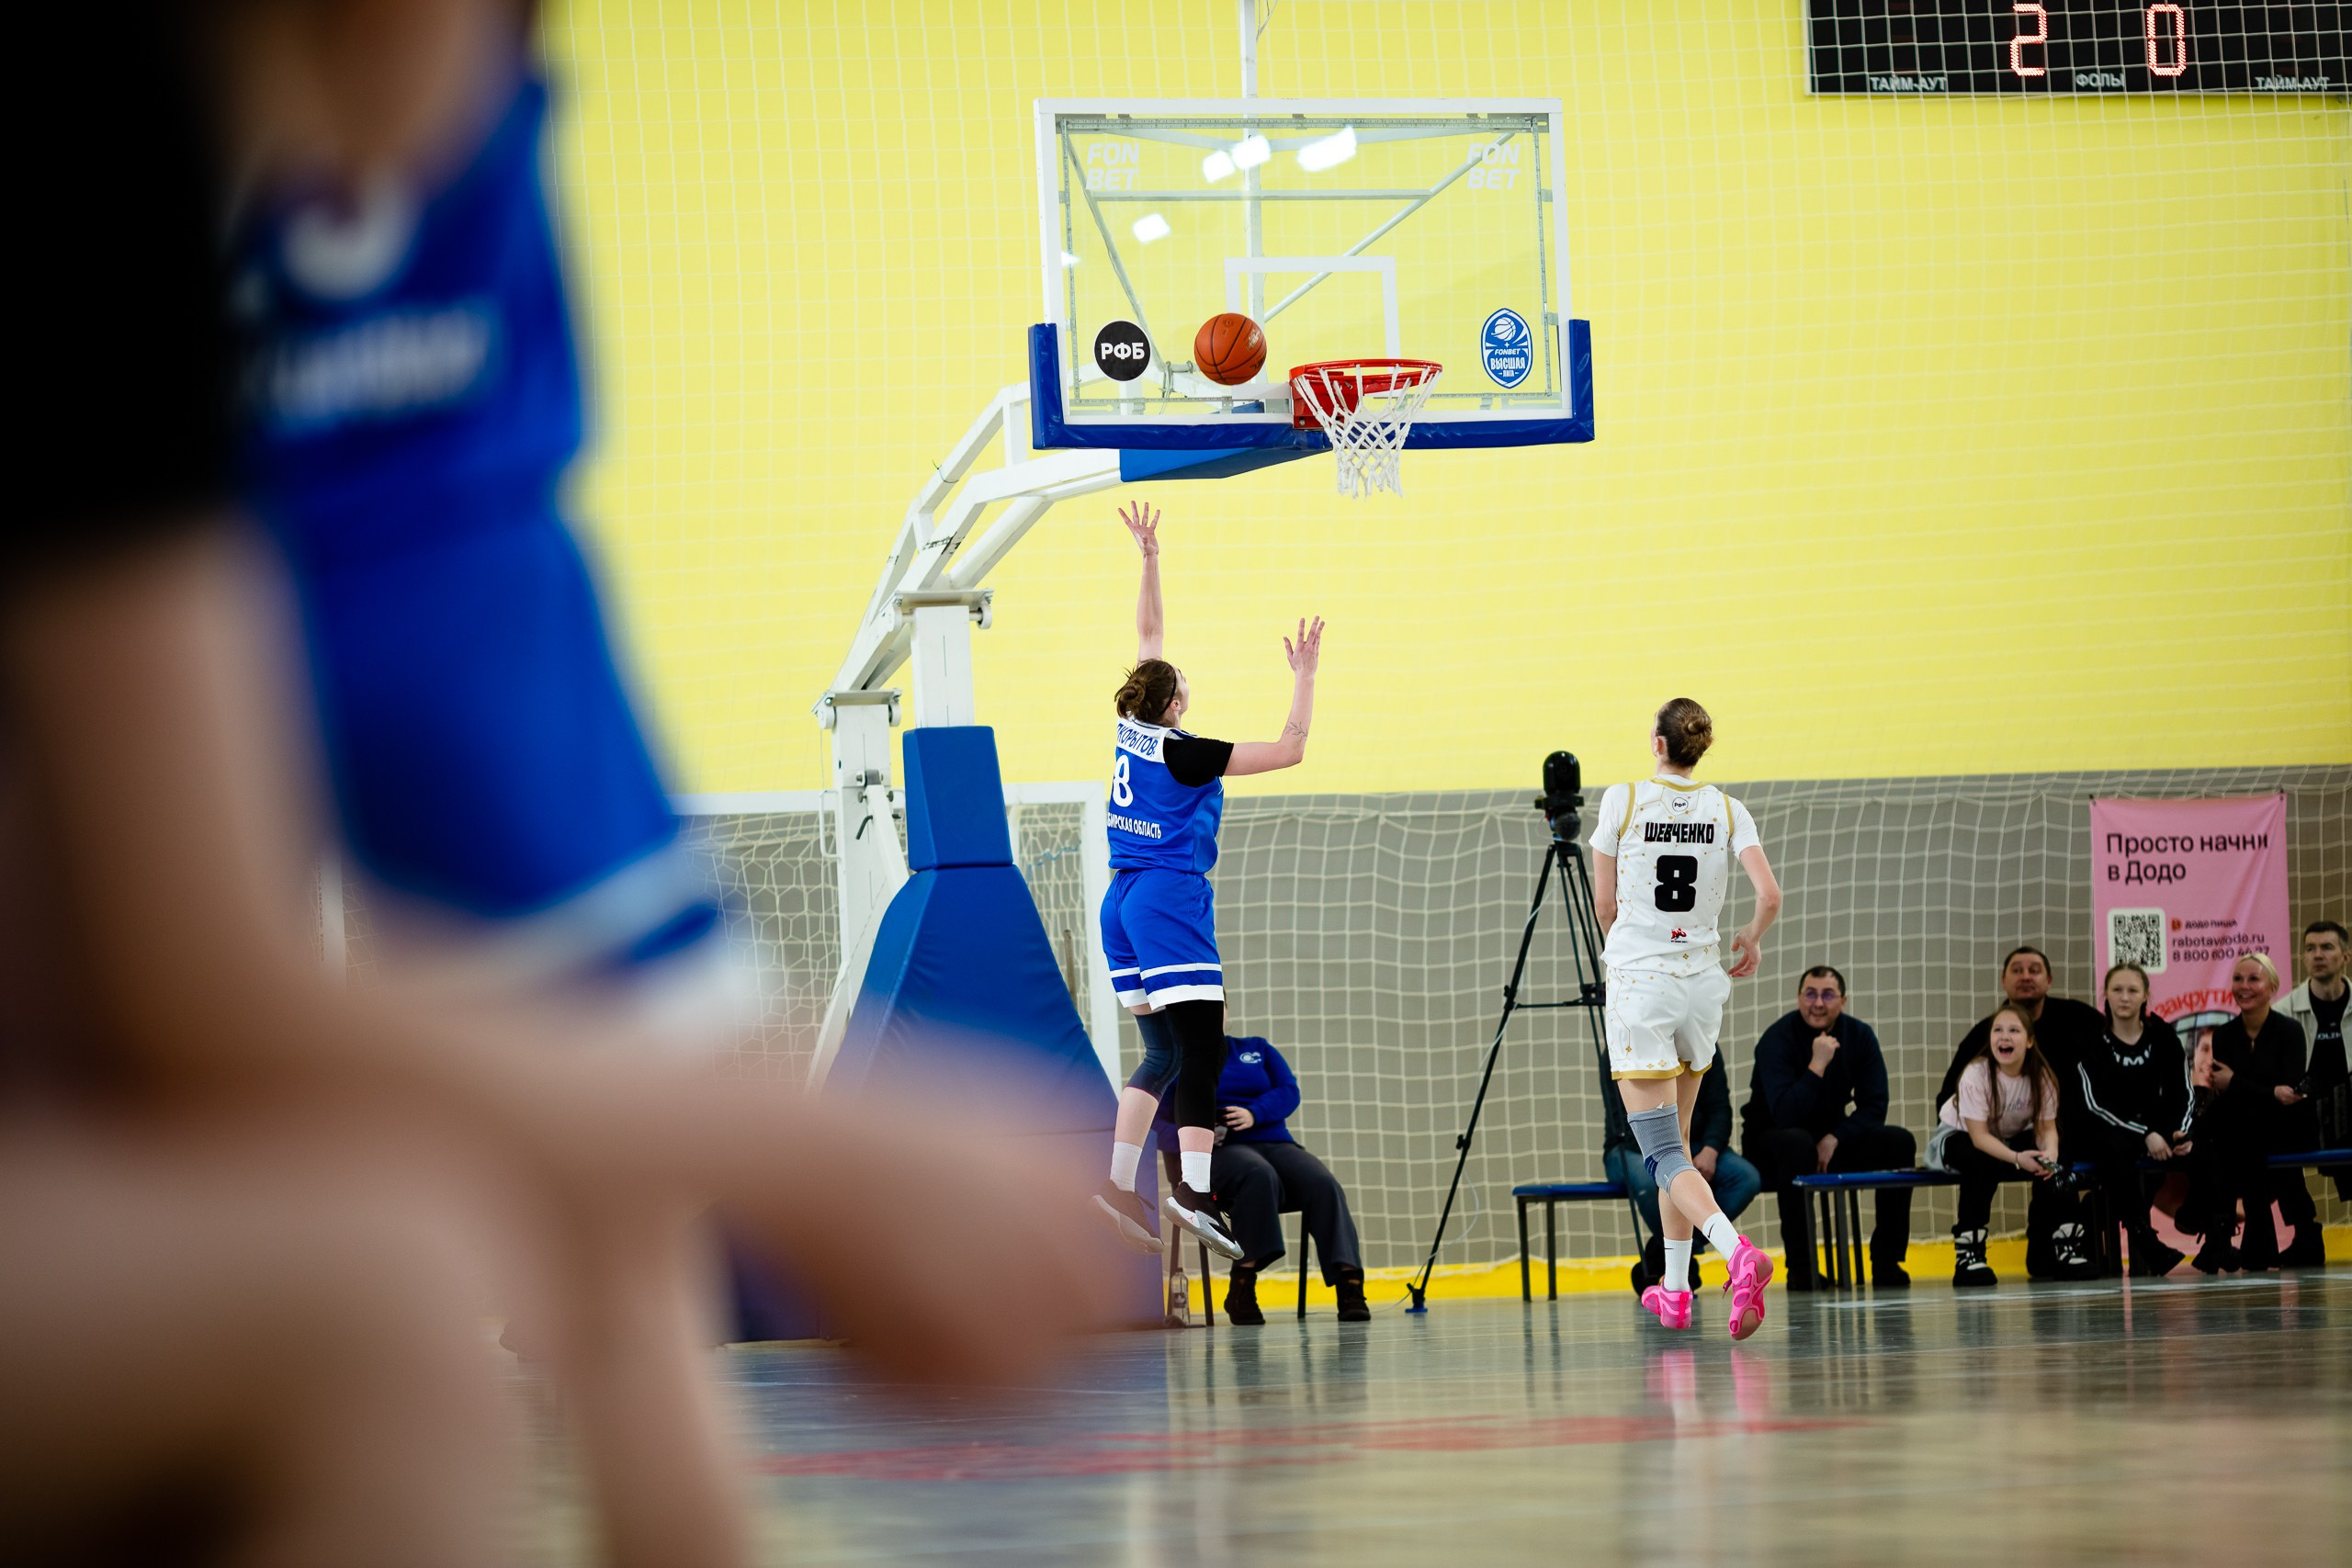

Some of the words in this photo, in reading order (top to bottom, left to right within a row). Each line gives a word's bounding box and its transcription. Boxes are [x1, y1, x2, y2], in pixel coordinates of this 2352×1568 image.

[2010, 4, 2047, 76] 2
[2147, 4, 2187, 77] 0
[1870, 73, 1947, 91] ТАЙМ-АУТ
[2075, 73, 2124, 87] ФОЛЫ
[2255, 74, 2330, 90] ТАЙМ-АУТ
[1088, 142, 1139, 165] FON
[1466, 142, 1521, 164] FON
[1086, 168, 1139, 190] BET
[1467, 167, 1521, 190] BET
[1101, 342, 1145, 360] РФБ
[1490, 356, 1525, 369] ВЫСШАЯ
[1133, 818, 1161, 839] ОБЛАСТЬ
[1645, 822, 1714, 843] ШЕВЧЕНКО
[2107, 833, 2194, 858] Просто
[2199, 833, 2267, 852] начни
[1655, 855, 1698, 912] 8
[2108, 864, 2120, 881] в
[2125, 861, 2187, 885] Додо
[2173, 950, 2181, 962] 8
[2184, 949, 2210, 962] 800
